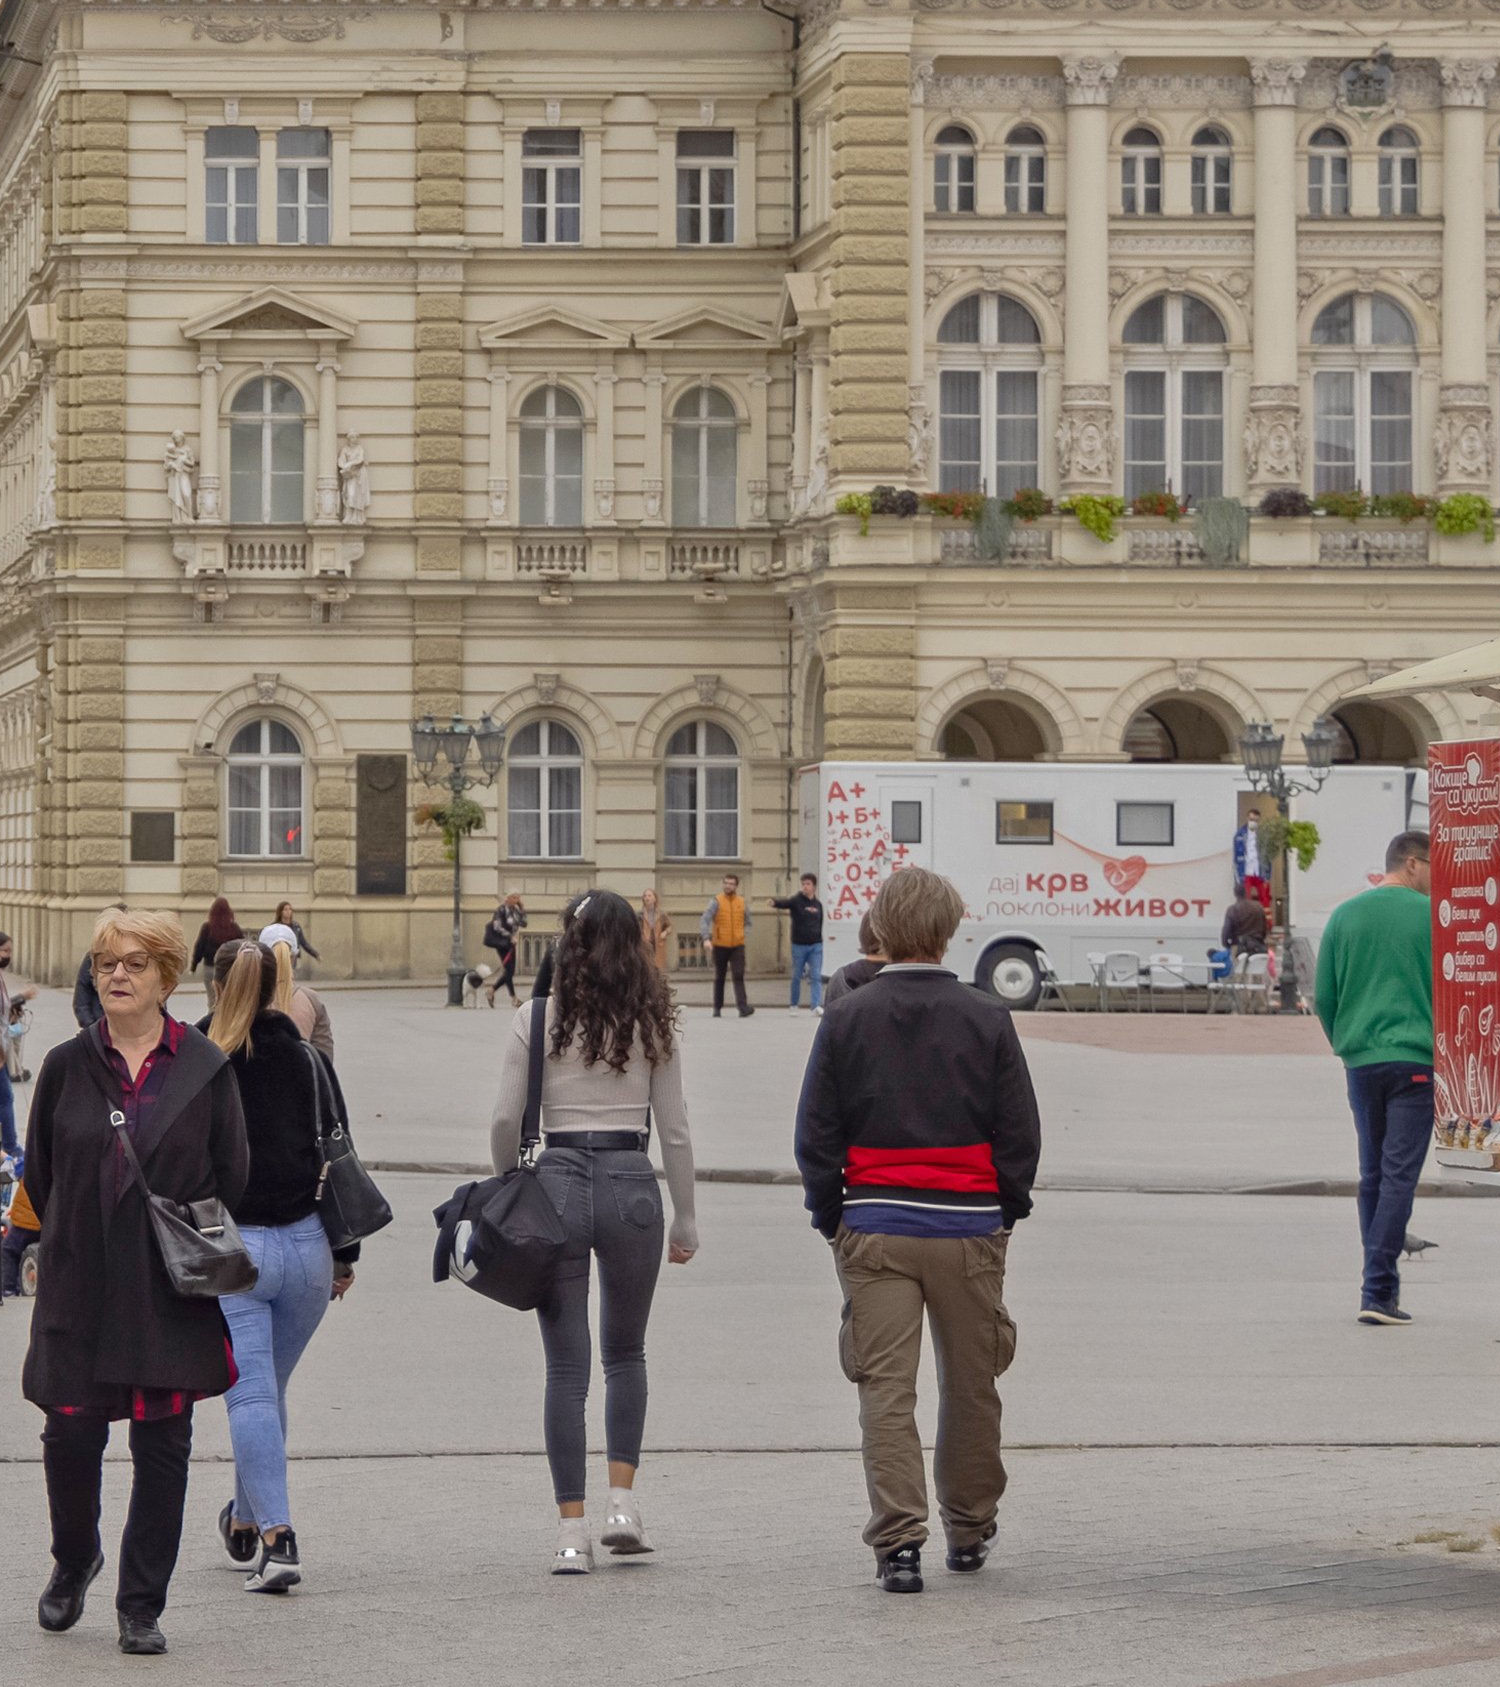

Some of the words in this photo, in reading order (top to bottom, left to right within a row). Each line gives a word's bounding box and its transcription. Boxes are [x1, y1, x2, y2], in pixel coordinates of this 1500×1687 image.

[1433, 768, 1467, 790] Кокице
[1449, 787, 1460, 804] са
[1462, 786, 1499, 808] укусом!
[1437, 823, 1450, 843] За
[1451, 823, 1499, 849] труднице
[1453, 841, 1492, 867] гратис!
[987, 876, 1019, 896] дај
[1026, 873, 1089, 898] крв
[1451, 885, 1484, 898] пилетина
[986, 901, 1091, 917] поклони
[1452, 906, 1468, 920] бели
[1468, 907, 1481, 924] лук
[1457, 930, 1485, 946] роштиљ
[1454, 951, 1476, 969] бибер
[1476, 954, 1485, 966] са
[1455, 969, 1475, 983] белим
[1476, 971, 1498, 988] луком
